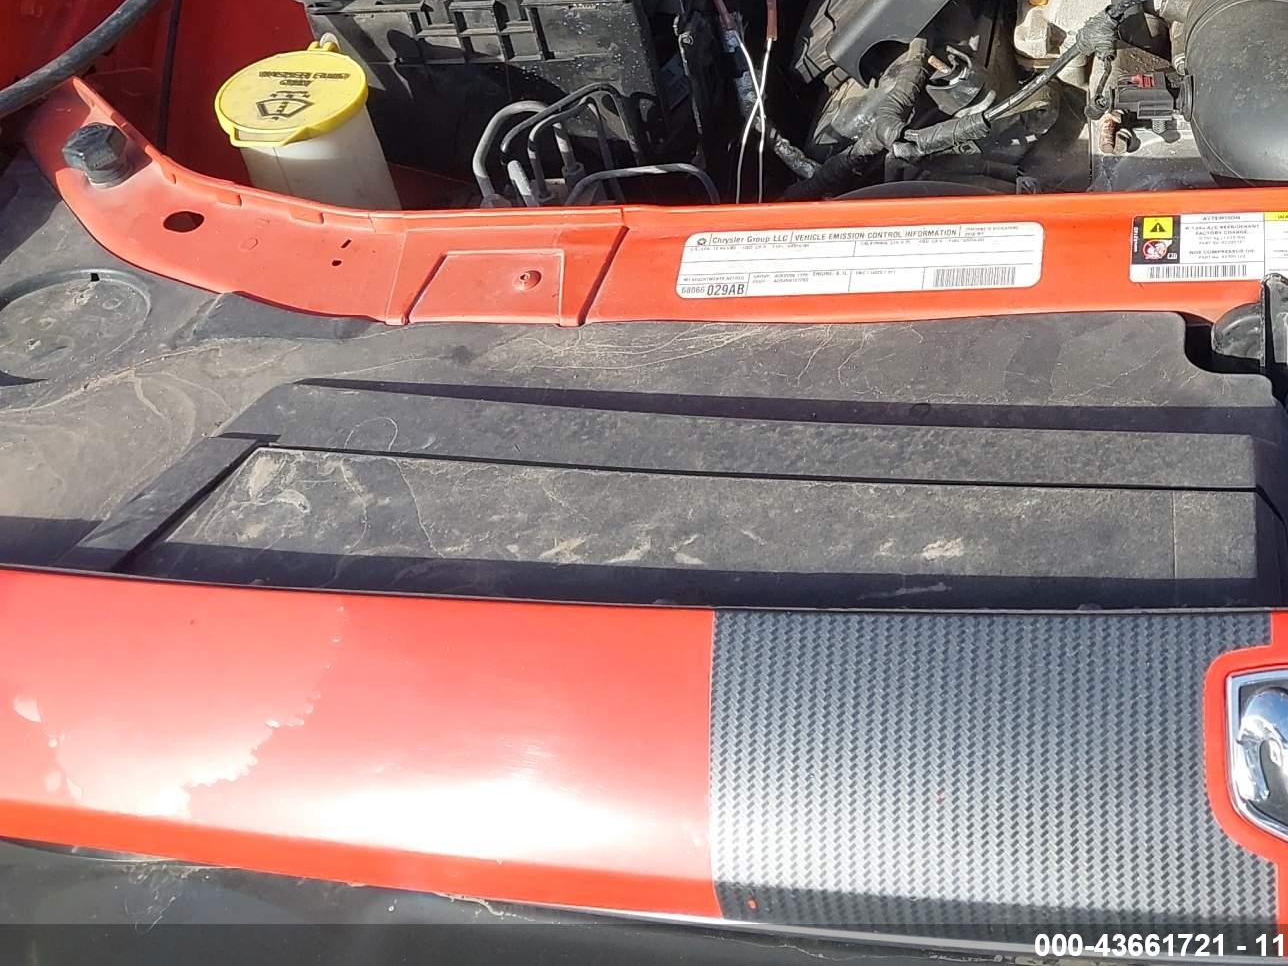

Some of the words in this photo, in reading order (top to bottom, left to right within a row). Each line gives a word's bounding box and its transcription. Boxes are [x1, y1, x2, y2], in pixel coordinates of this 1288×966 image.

[712, 236, 744, 245] Chrysler
[747, 235, 770, 243] Group
[773, 234, 788, 242] LLC
[795, 233, 826, 241] VEHICLE
[828, 232, 864, 240] EMISSION
[867, 231, 902, 239] CONTROL
[905, 229, 957, 238] INFORMATION
[706, 284, 745, 296] 029AB
